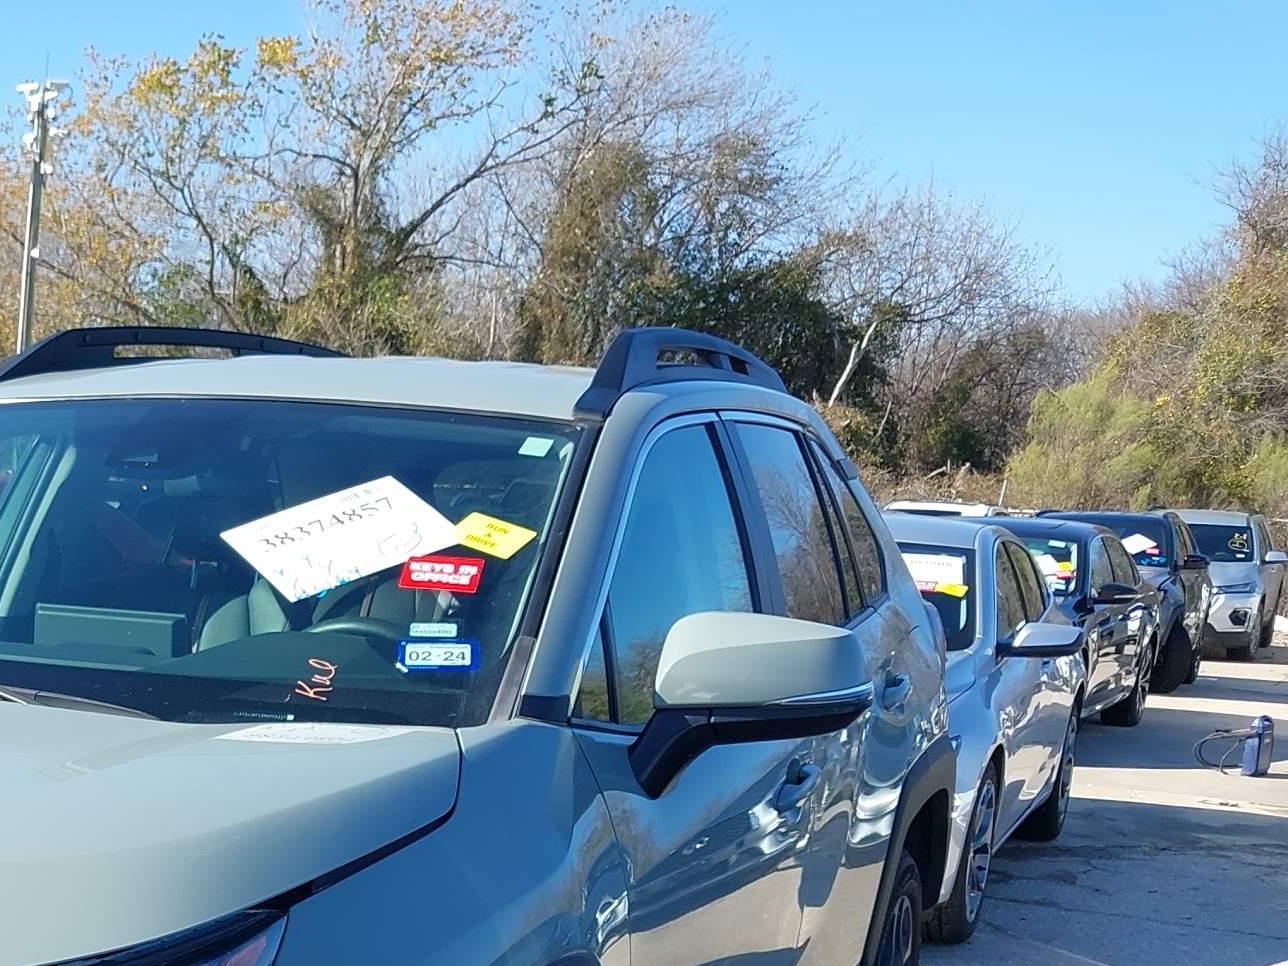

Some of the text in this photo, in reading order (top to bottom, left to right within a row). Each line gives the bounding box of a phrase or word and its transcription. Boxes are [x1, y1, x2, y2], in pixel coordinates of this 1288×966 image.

[256, 495, 394, 553] 38374857
[409, 561, 455, 574] KEYS
[410, 572, 472, 585] OFFICE
